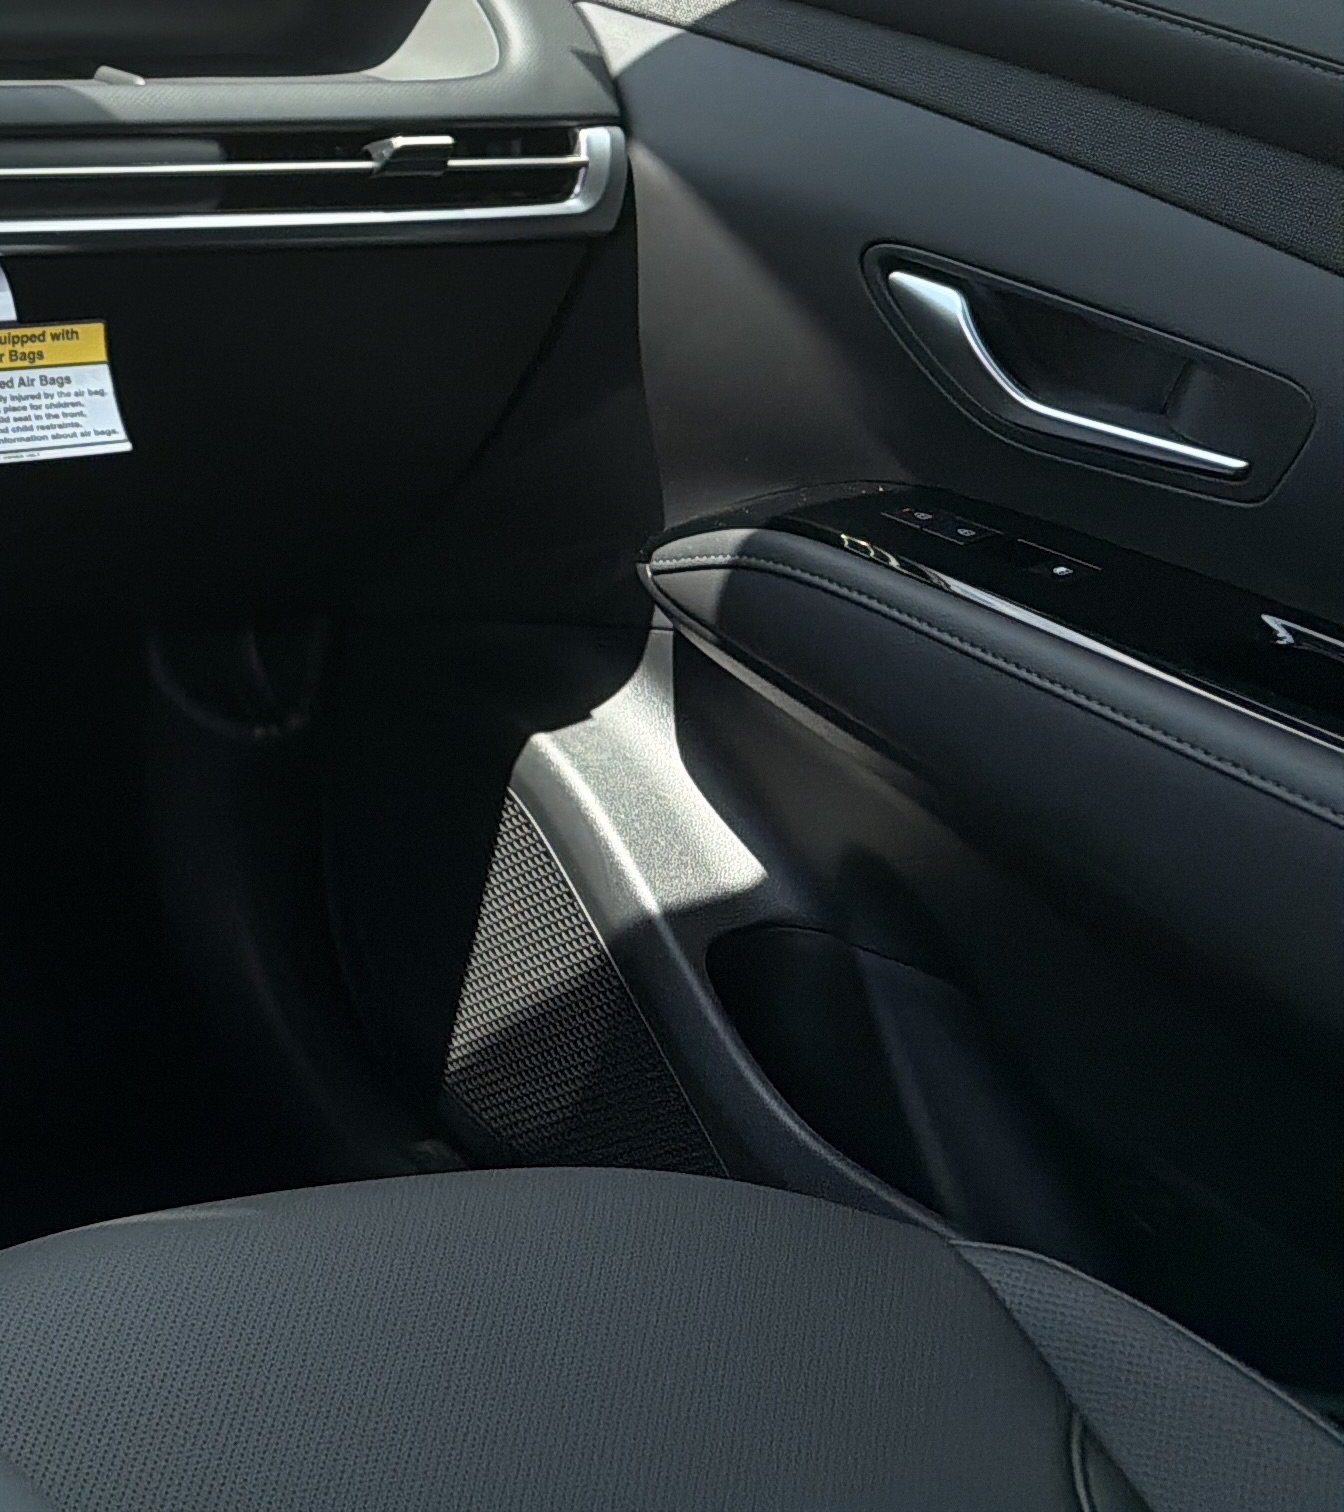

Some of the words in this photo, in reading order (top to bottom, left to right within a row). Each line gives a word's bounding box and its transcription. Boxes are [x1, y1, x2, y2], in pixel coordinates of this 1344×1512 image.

[50, 328, 80, 341] with
[9, 349, 44, 364] Bags
[17, 375, 36, 388] Air
[39, 374, 72, 388] Bags
[9, 391, 42, 403] injured
[57, 390, 71, 398] the
[73, 389, 85, 397] air
[3, 404, 28, 414] place
[29, 403, 42, 411] for
[13, 414, 32, 423] seat
[44, 412, 60, 420] the
[11, 424, 34, 433] child
[50, 431, 78, 440] about
[80, 429, 92, 438] air
